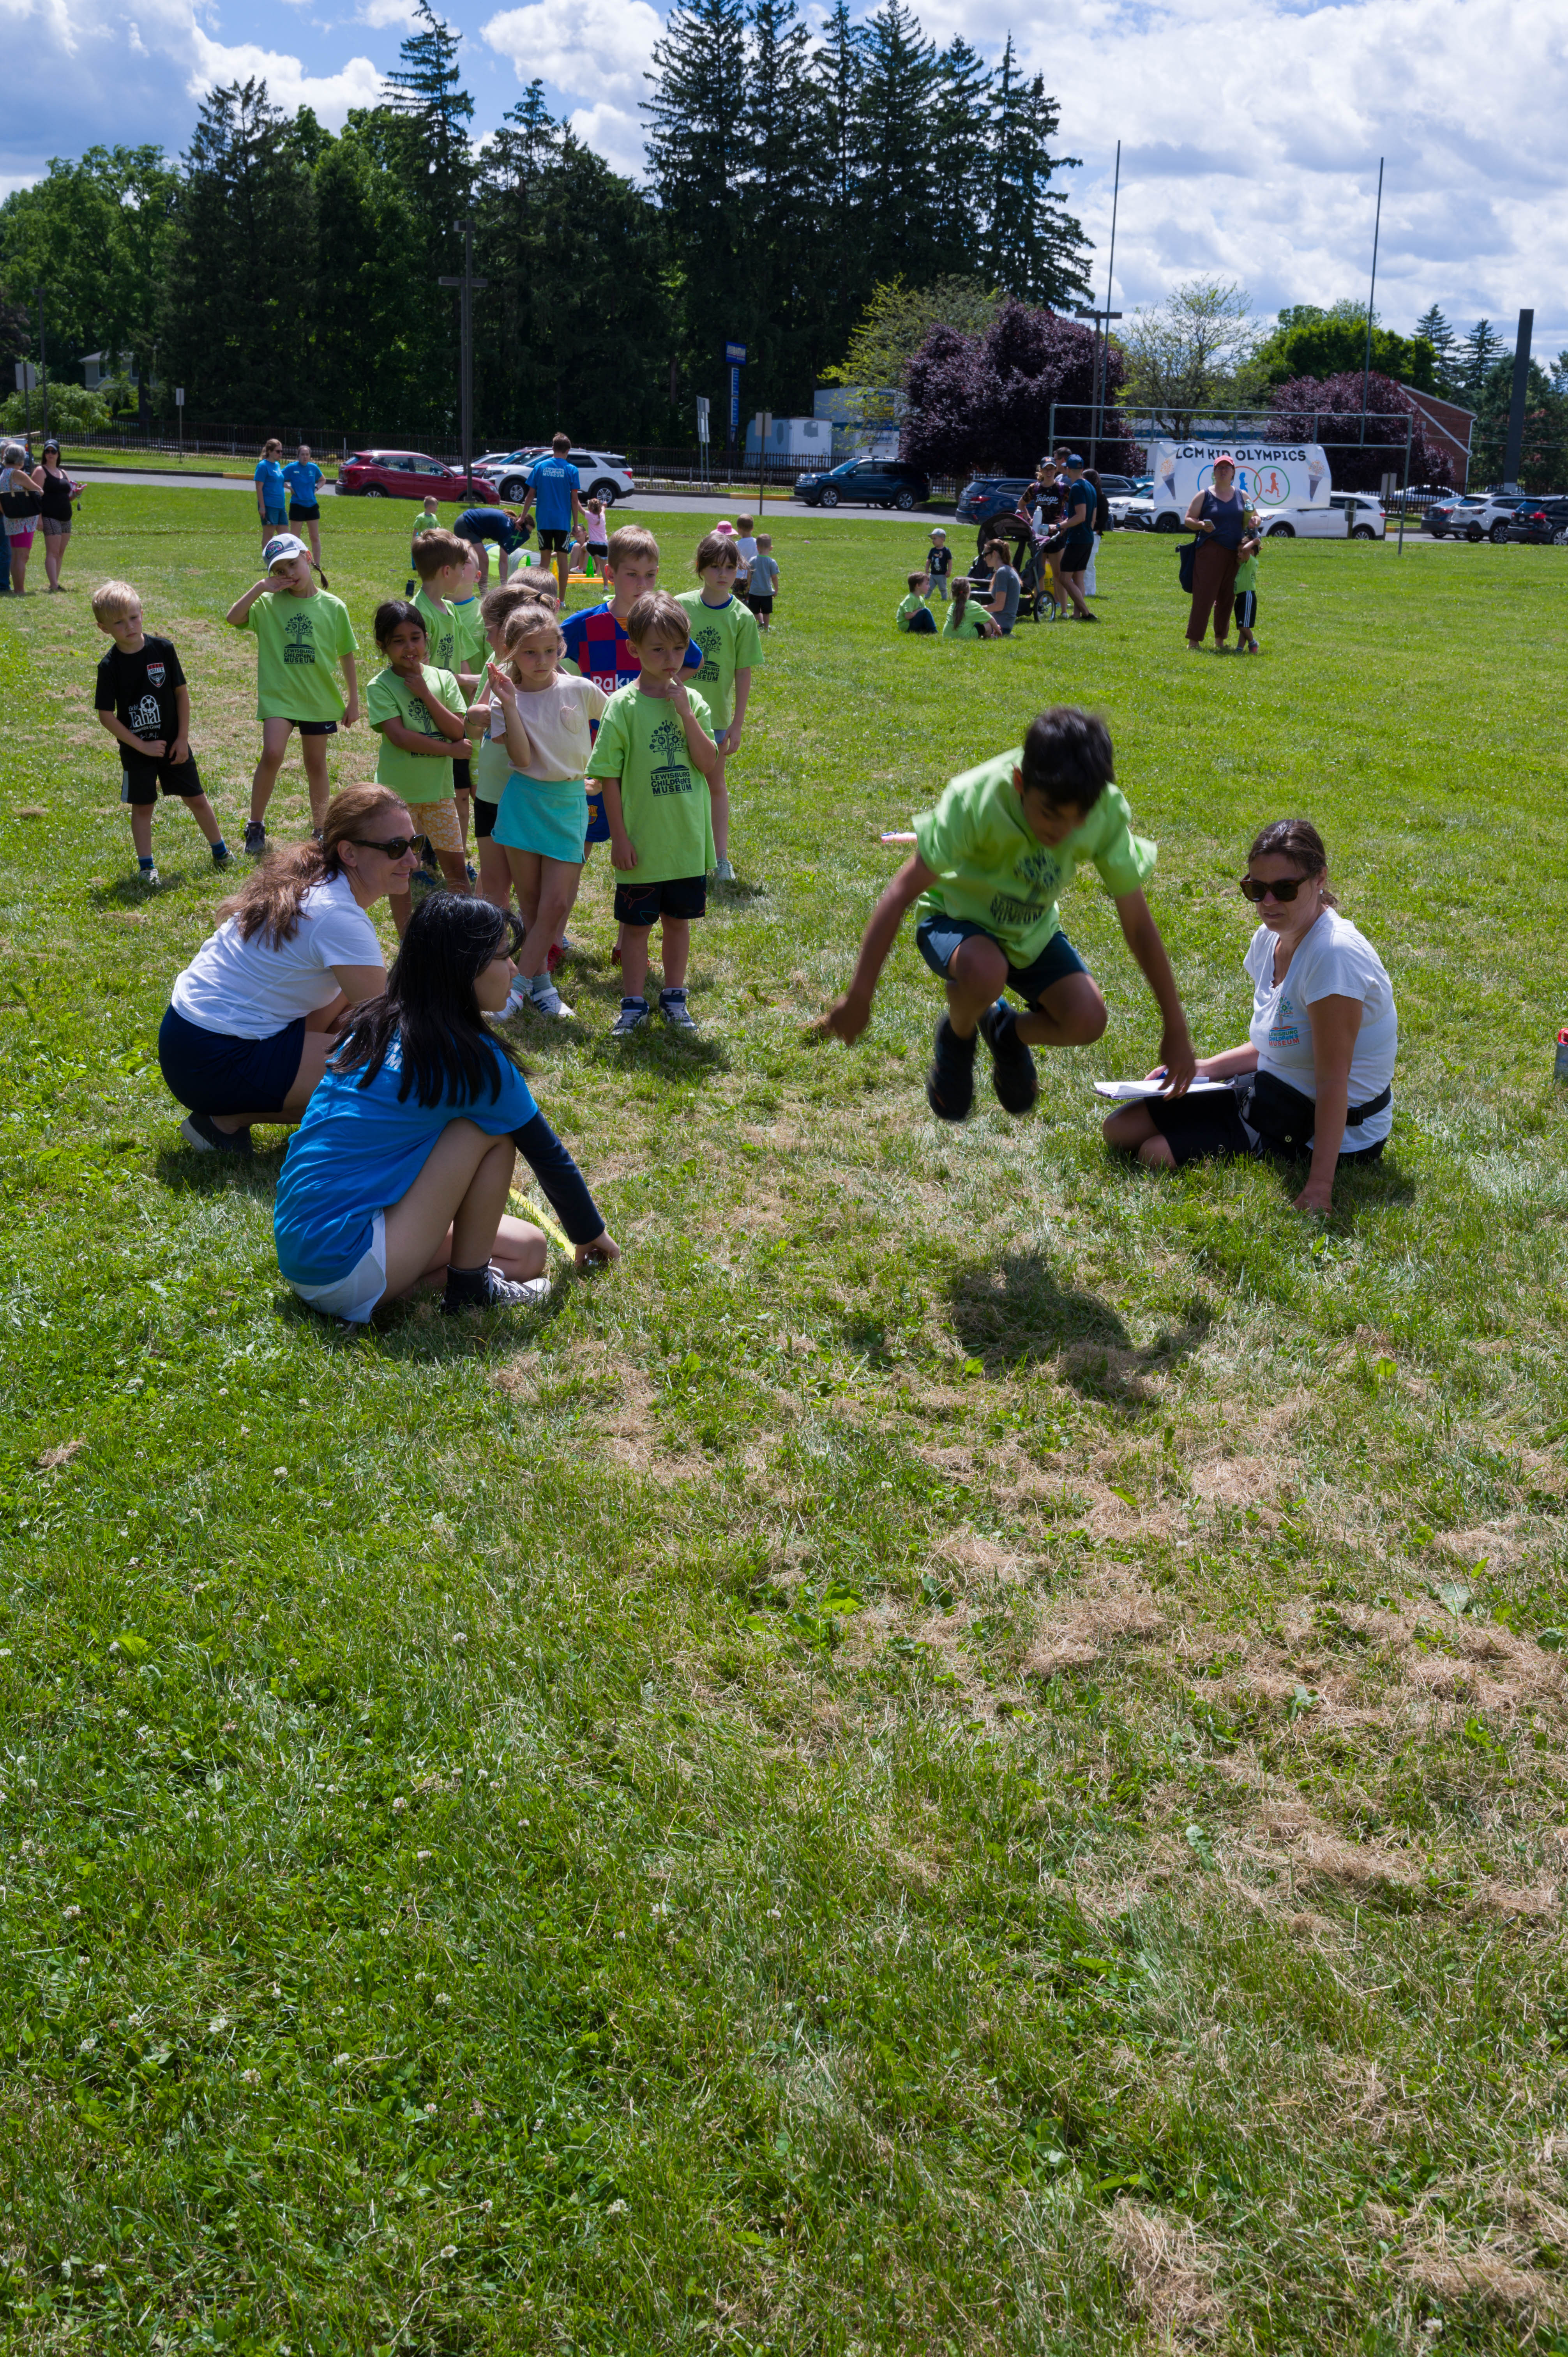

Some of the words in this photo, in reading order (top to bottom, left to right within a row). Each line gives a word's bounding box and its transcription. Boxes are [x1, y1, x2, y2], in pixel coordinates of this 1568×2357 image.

[1176, 447, 1204, 459] LCM
[1235, 449, 1306, 461] OLYMPICS
[129, 725, 149, 733] utomotive
[651, 772, 690, 781] LEWISBURG
[651, 778, 691, 787] CHILDREN'S
[652, 784, 692, 795] MUSEUM
